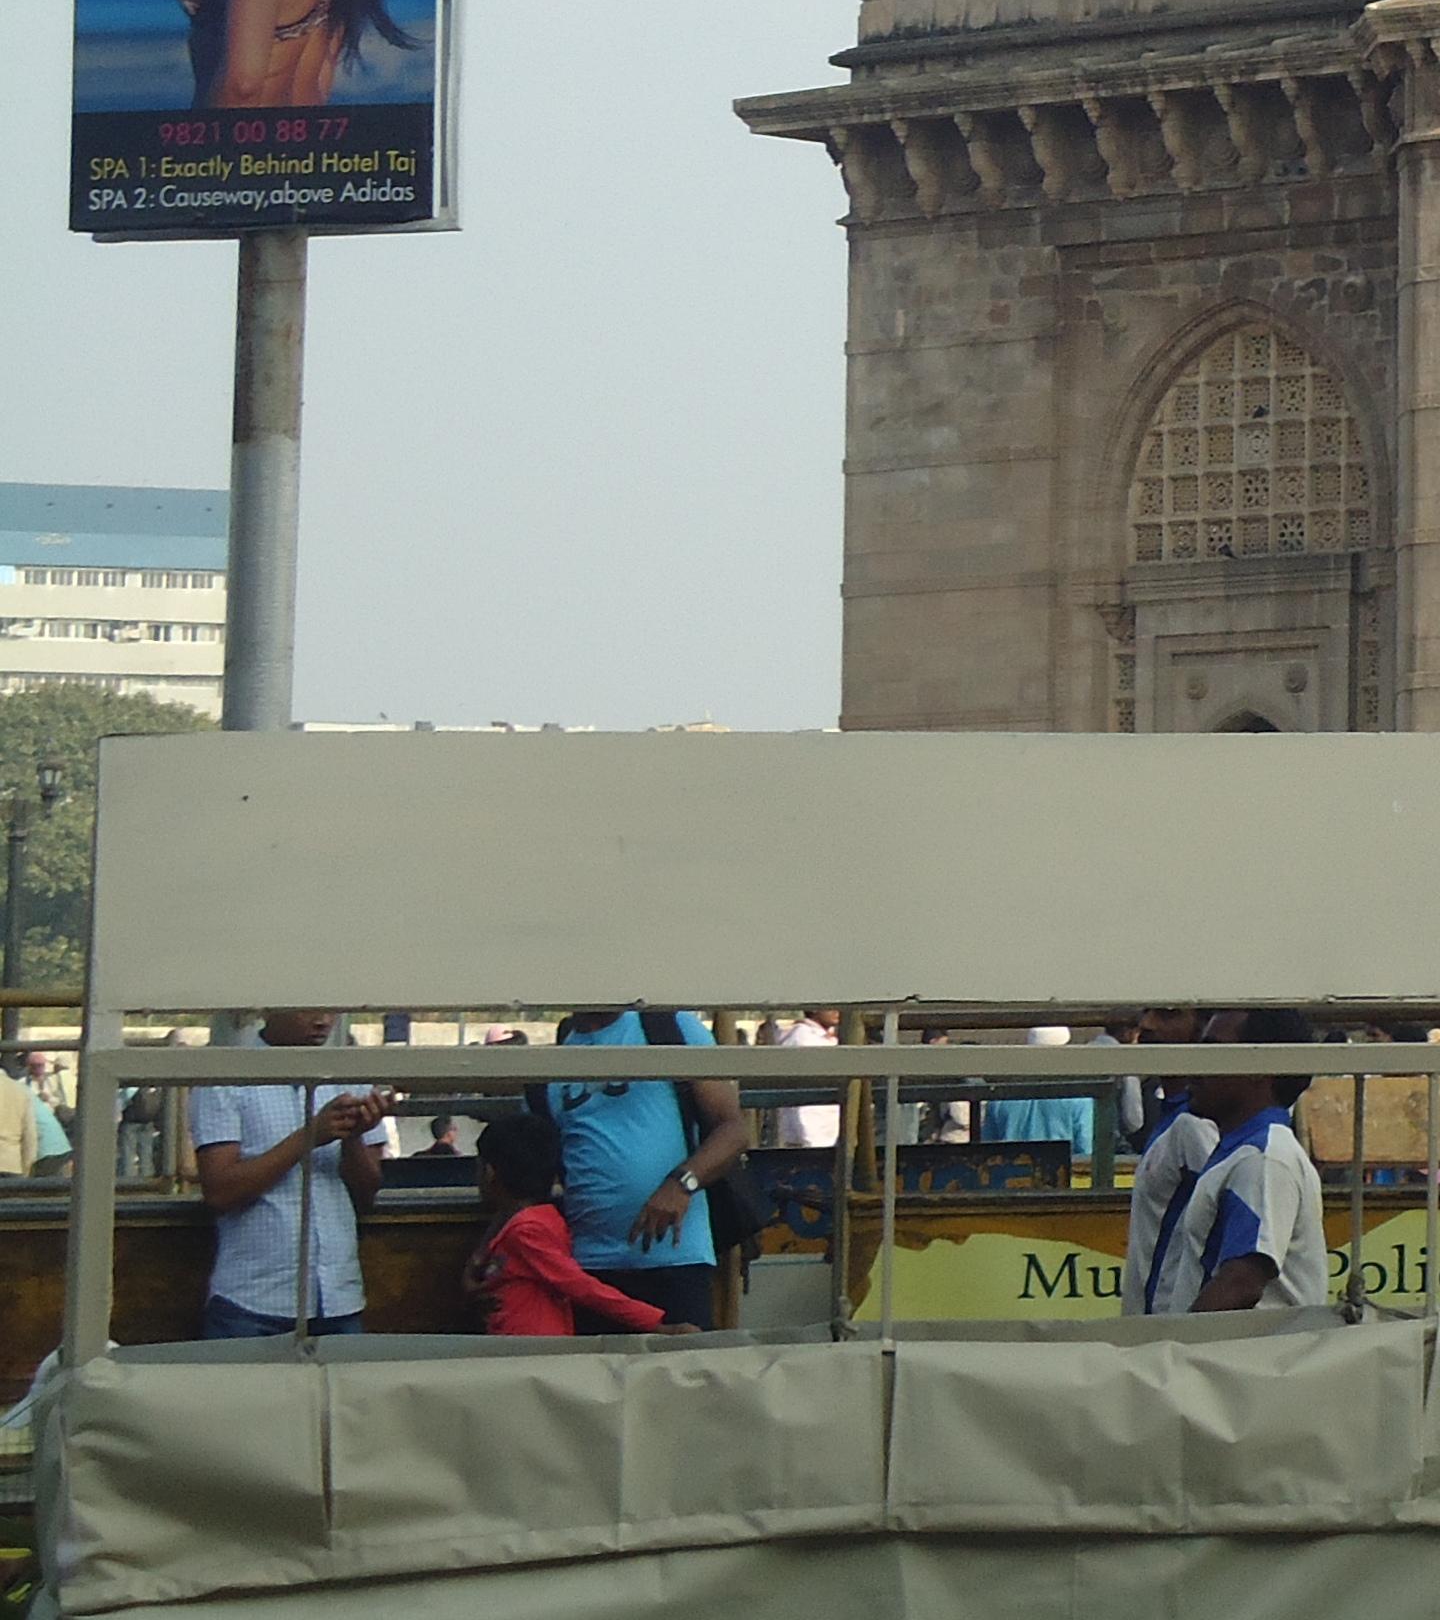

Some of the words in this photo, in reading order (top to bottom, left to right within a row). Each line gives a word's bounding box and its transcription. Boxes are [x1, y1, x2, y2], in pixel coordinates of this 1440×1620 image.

[160, 121, 221, 146] 9821
[233, 121, 266, 142] 00
[275, 118, 307, 141] 88
[318, 117, 349, 141] 77
[89, 157, 130, 180] SPA
[160, 155, 233, 182] Exactly
[239, 152, 314, 177] Behind
[321, 151, 379, 174] Hotel
[386, 149, 417, 176] Taj
[88, 188, 128, 212] SPA
[339, 179, 416, 204] Adidas
